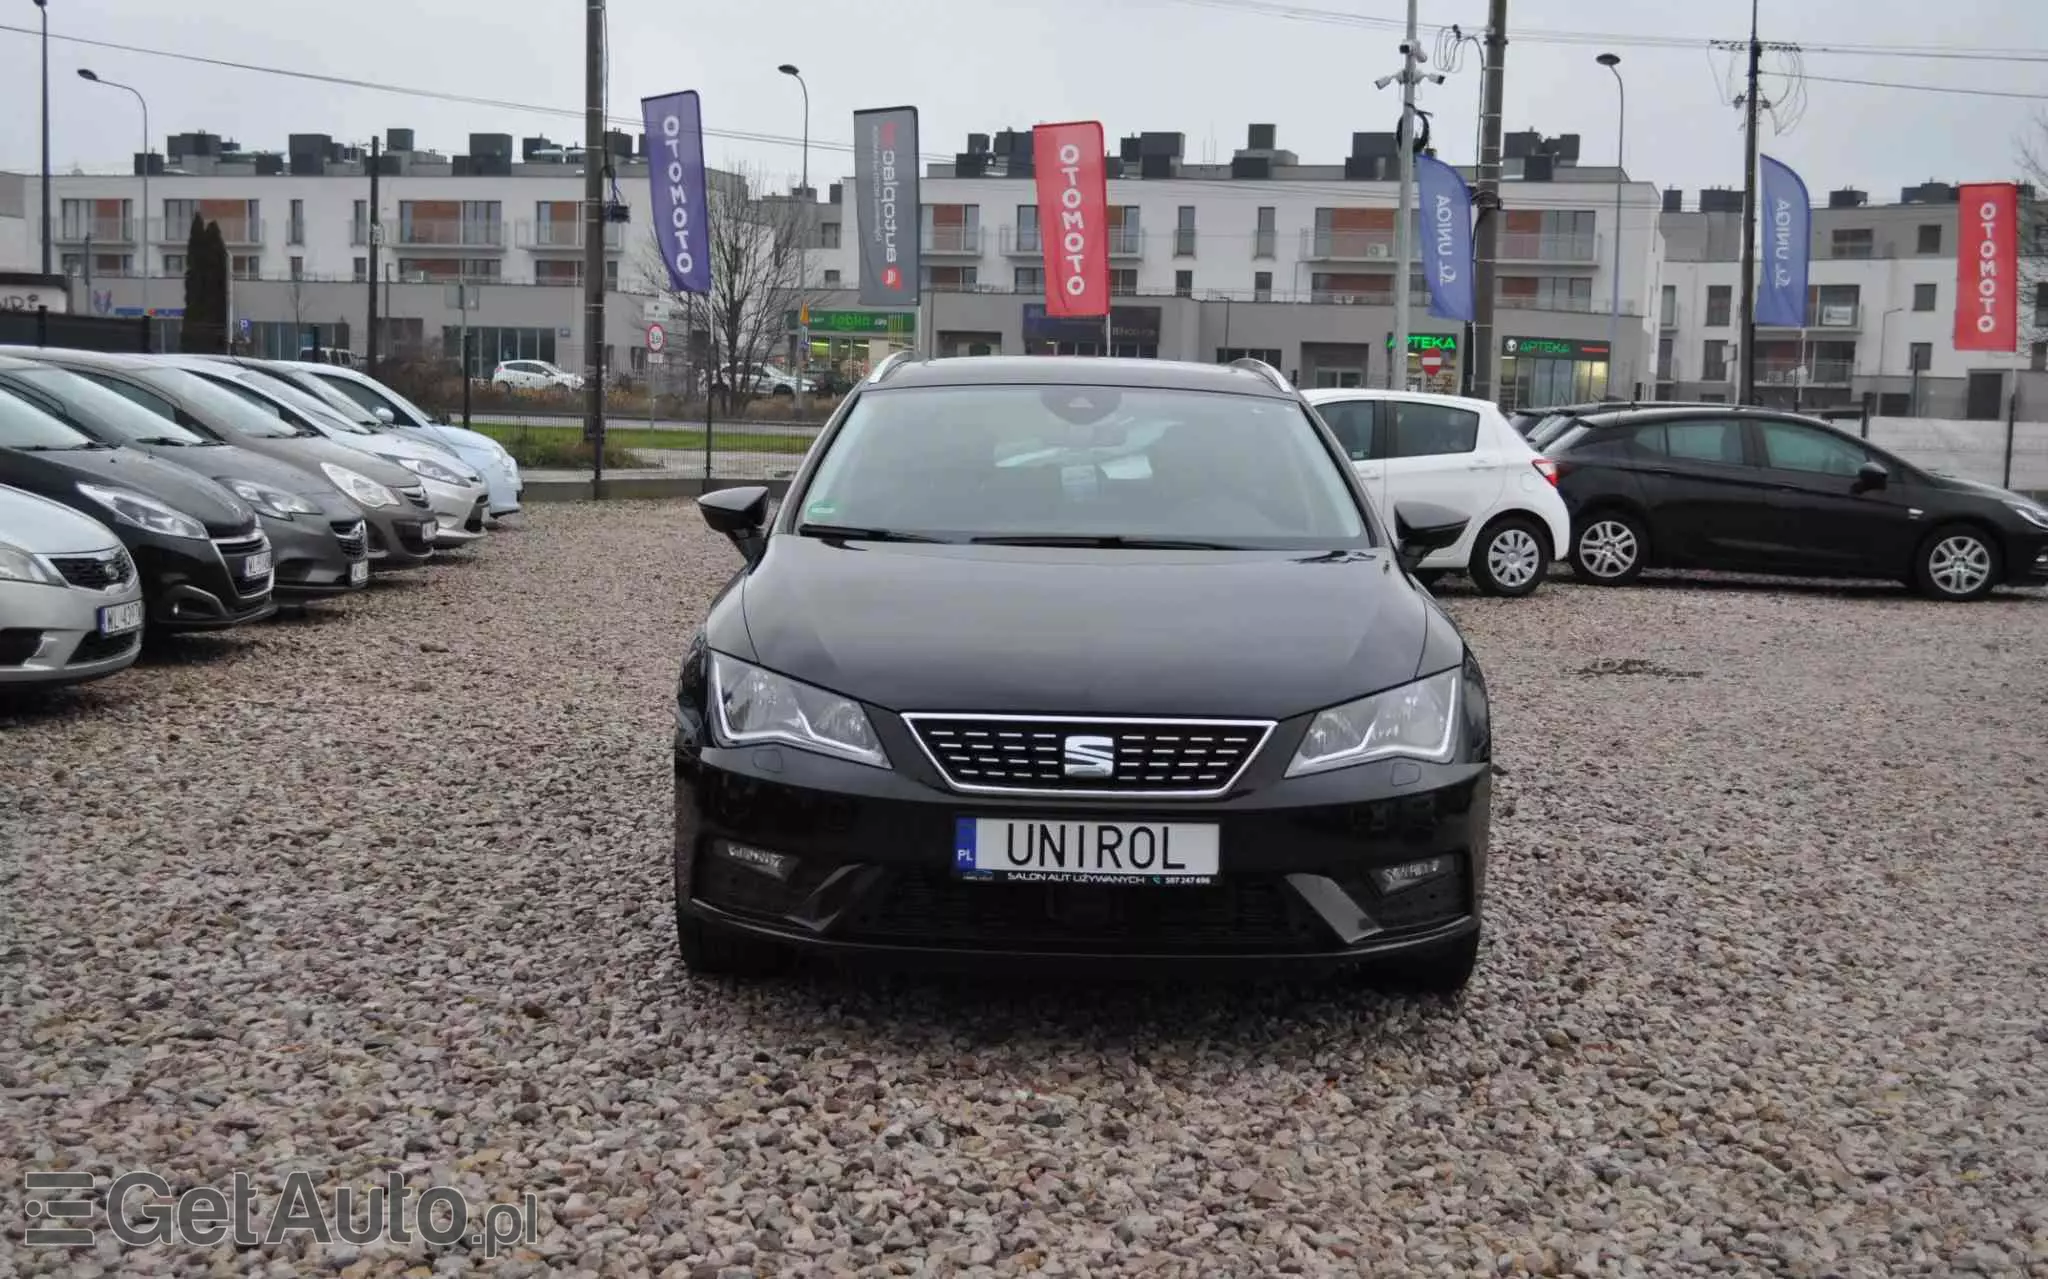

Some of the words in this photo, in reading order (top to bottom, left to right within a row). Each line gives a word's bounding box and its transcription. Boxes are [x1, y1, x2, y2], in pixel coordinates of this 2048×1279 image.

[663, 115, 693, 274] OTOMOTO
[1060, 144, 1085, 296] OTOMOTO
[1977, 202, 1997, 333] OTOMOTO
[1520, 341, 1570, 353] APTEKA
[957, 849, 973, 862] PL
[1008, 823, 1185, 869] UNIROL
[1007, 872, 1046, 881] SALON
[1047, 873, 1071, 882] AUT
